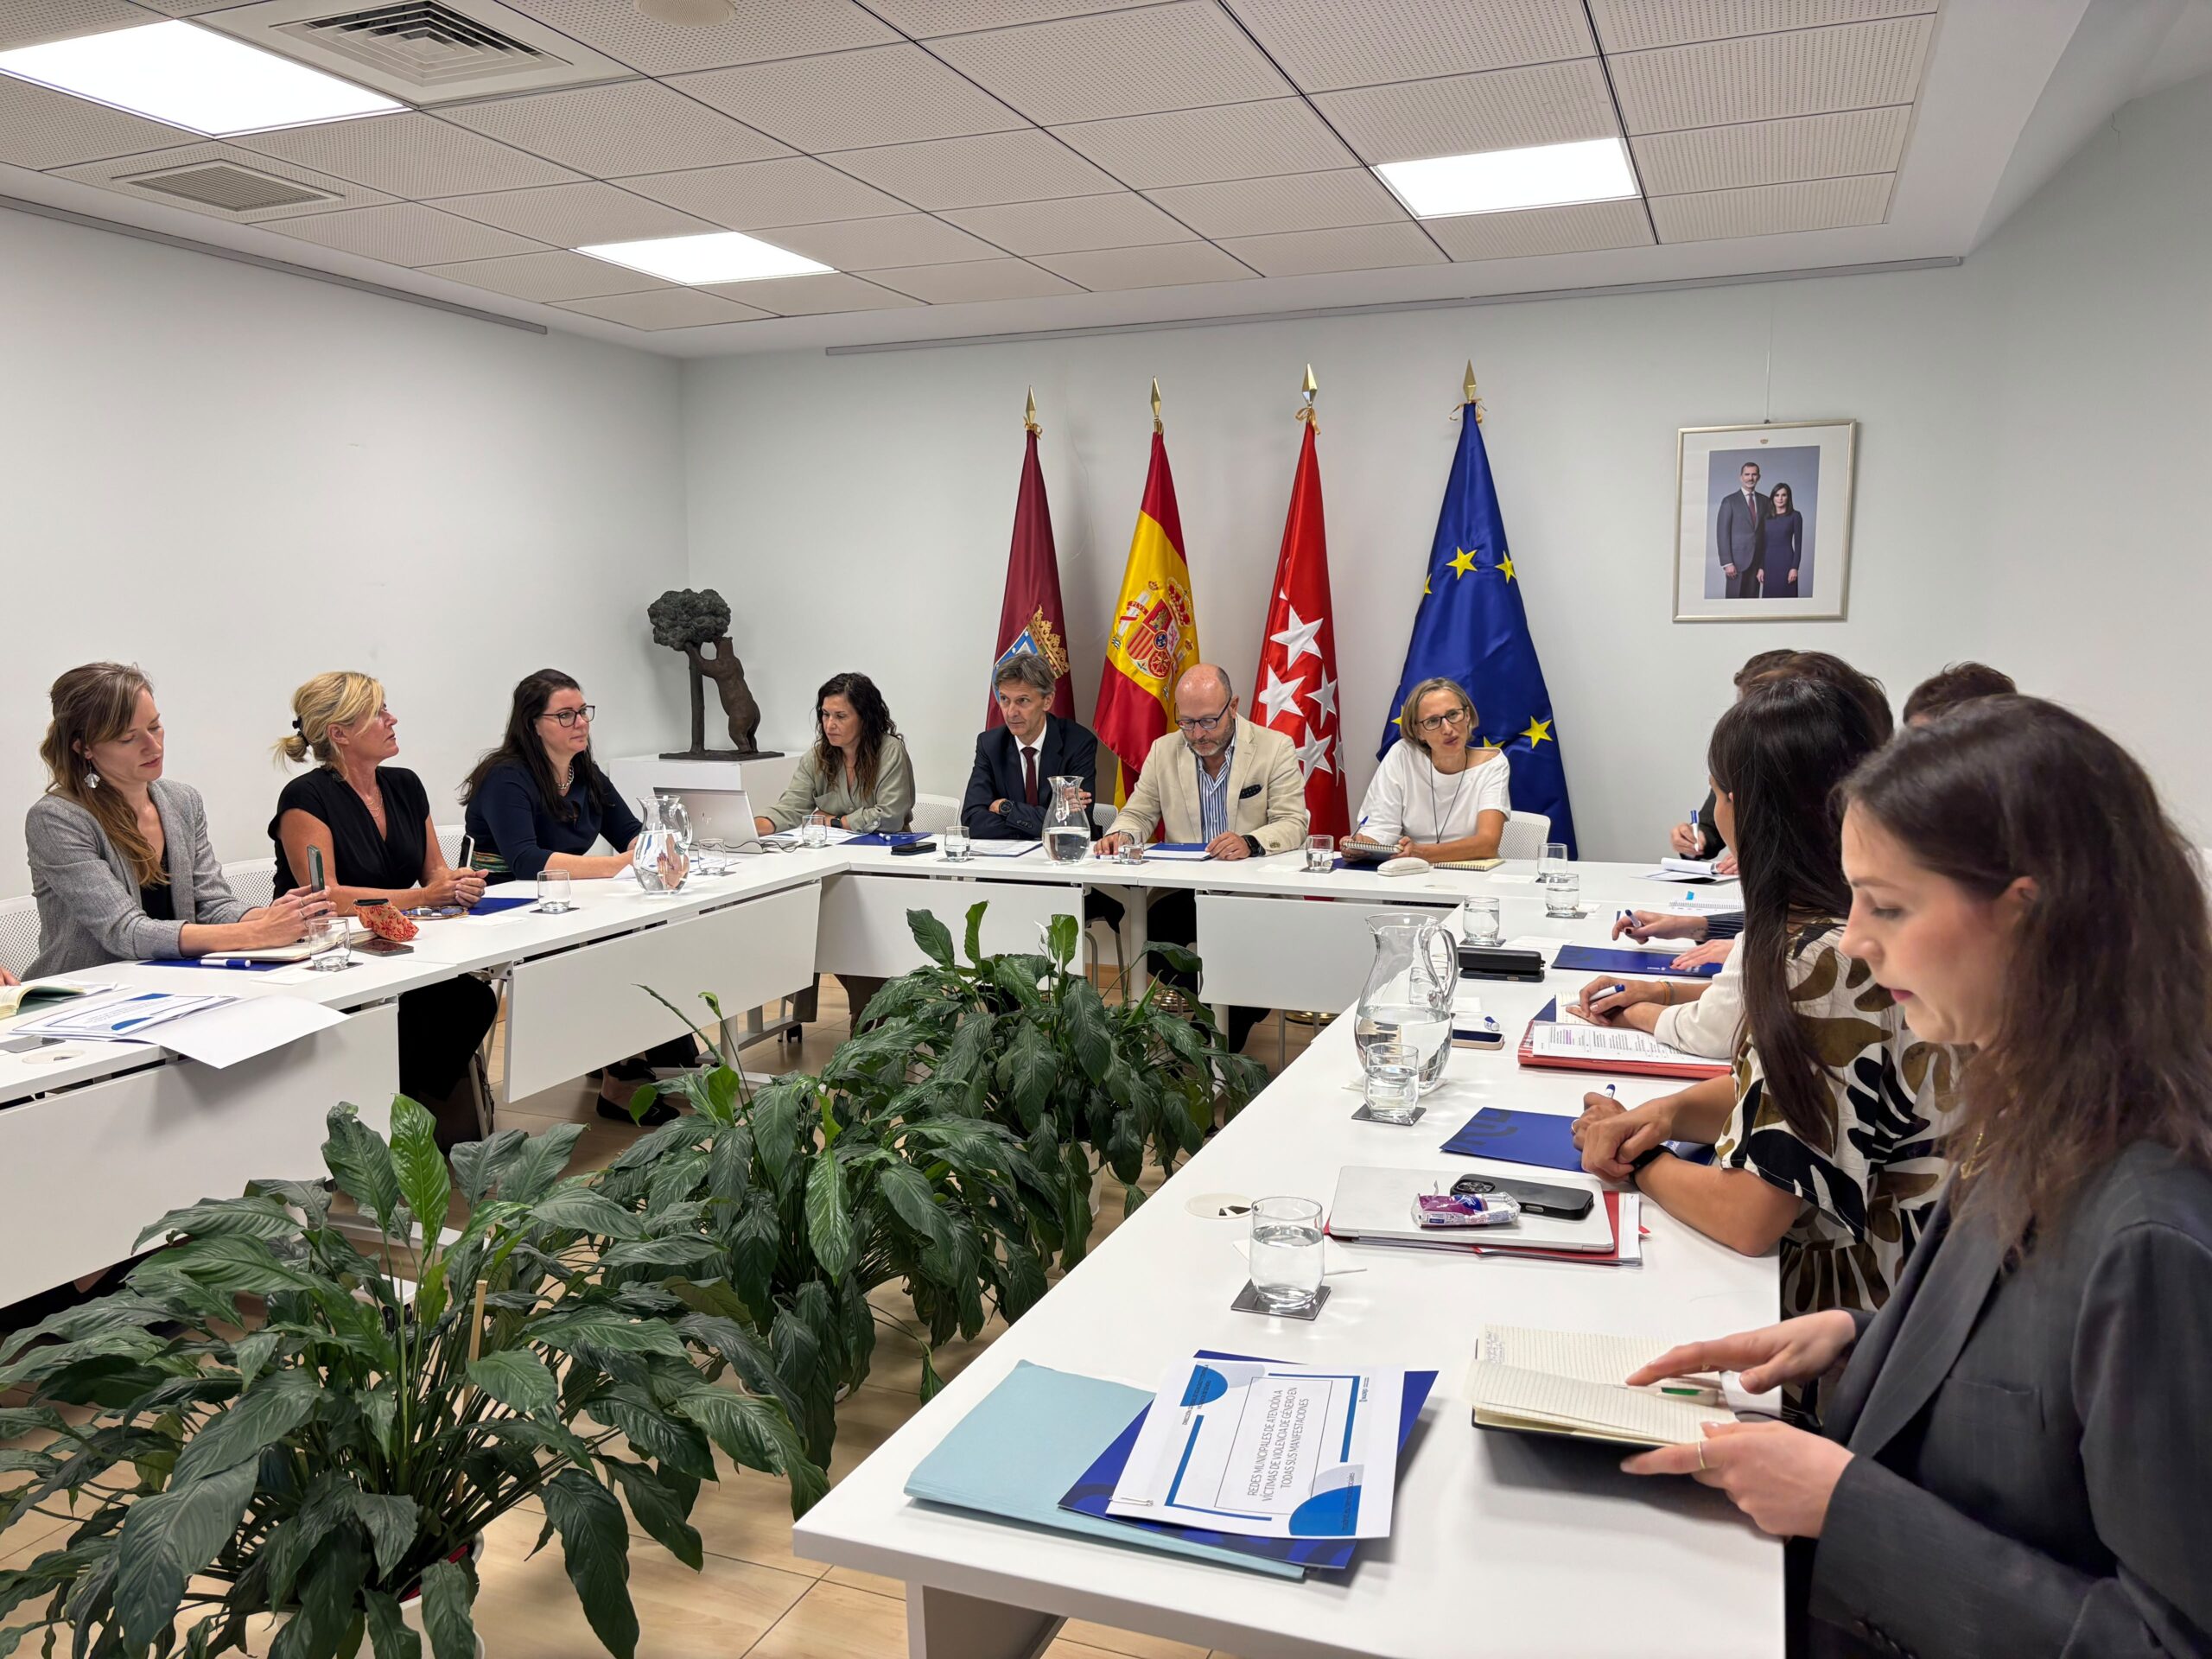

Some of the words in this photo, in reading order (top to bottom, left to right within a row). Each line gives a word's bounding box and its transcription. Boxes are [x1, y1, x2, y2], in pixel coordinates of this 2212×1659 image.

[1267, 1395, 1281, 1423] ATENCIÓN
[1281, 1395, 1295, 1419] GÉNERO
[1264, 1423, 1274, 1432] DE
[1279, 1419, 1290, 1427] DE
[1288, 1398, 1309, 1452] MANIFESTACIONES
[1254, 1432, 1272, 1473] MUNICIPALES
[1272, 1427, 1287, 1460] VIOLENCIA
[1270, 1460, 1281, 1470] DE
[1286, 1452, 1298, 1465] SUS
[1247, 1474, 1262, 1496] REDES
[1260, 1470, 1279, 1502] VÍCTIMAS
[1281, 1465, 1294, 1489] TODAS
